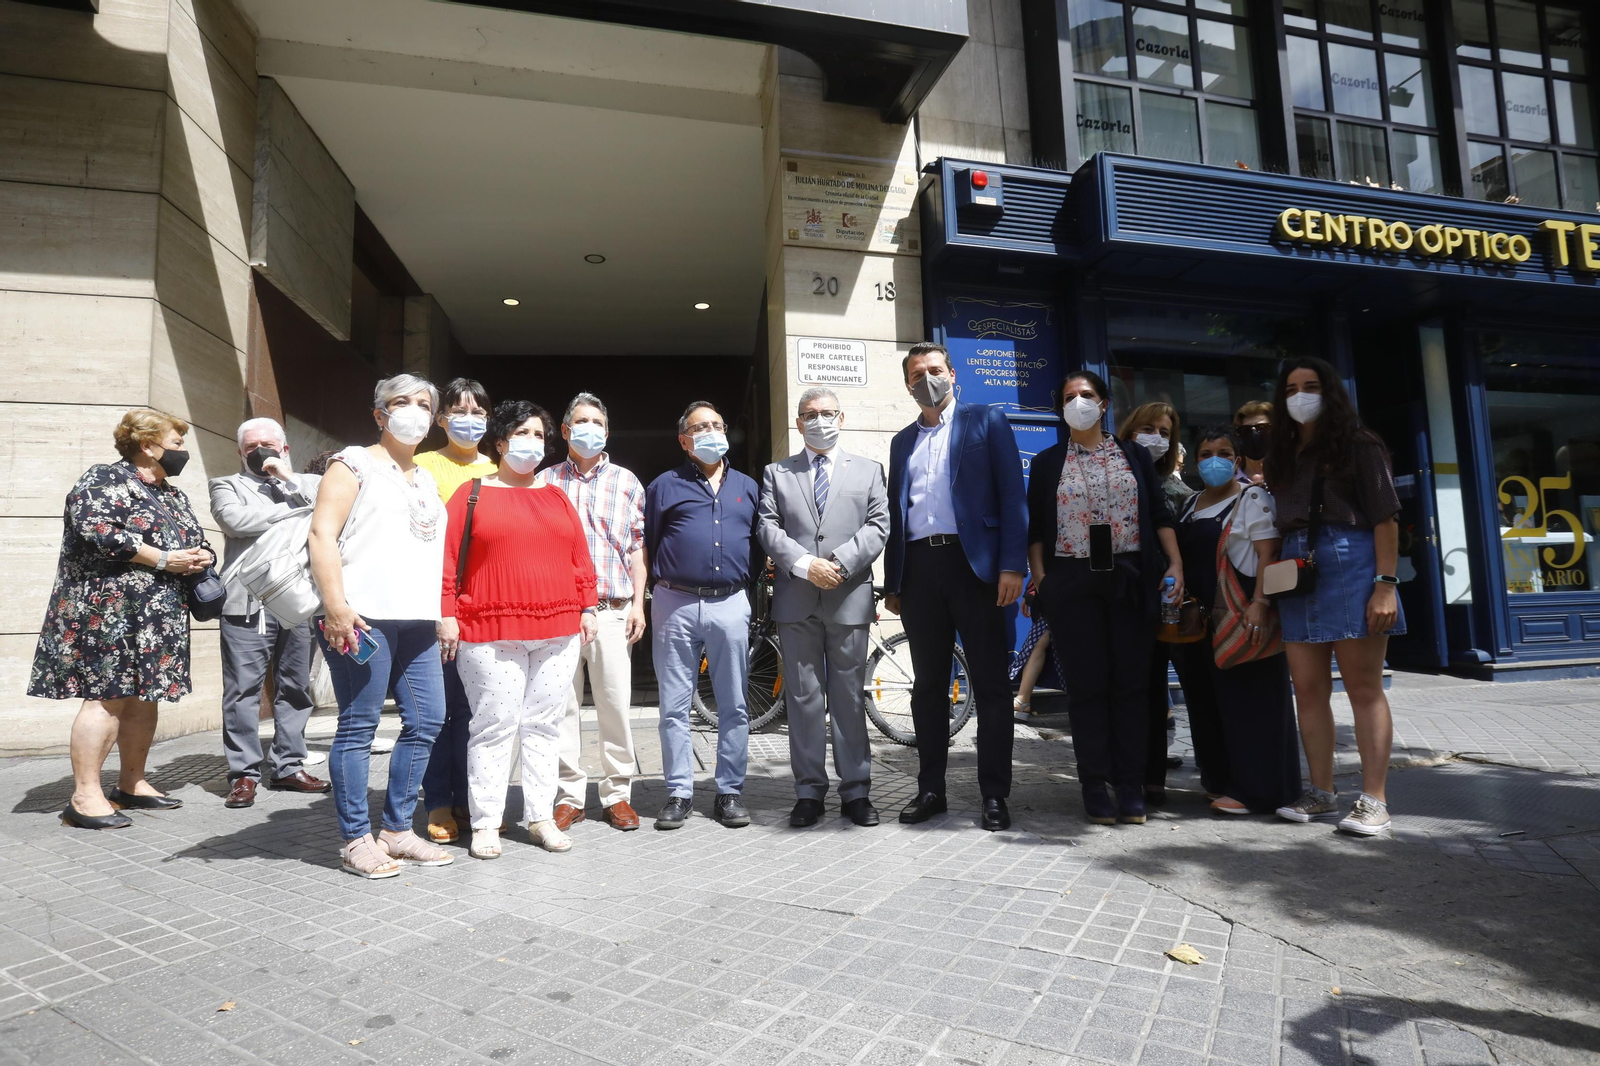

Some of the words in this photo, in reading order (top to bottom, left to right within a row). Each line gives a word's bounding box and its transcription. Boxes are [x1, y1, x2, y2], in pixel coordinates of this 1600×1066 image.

[1380, 4, 1424, 22] Cazorla
[1136, 39, 1190, 60] Cazorla
[1331, 73, 1379, 91] Cazorla
[1506, 101, 1548, 117] Cazorla
[1076, 114, 1131, 135] Cazorla
[795, 176, 816, 185] JULIÁN
[817, 178, 846, 188] HURTADO
[847, 181, 855, 189] DE
[856, 182, 879, 192] MOLINA
[880, 185, 907, 195] DELGADO
[1277, 208, 1414, 251] CENTRO
[1414, 224, 1532, 264] ÓPTICO
[1539, 220, 1600, 271] TE
[813, 277, 840, 297] 20
[875, 282, 897, 302] 18
[977, 322, 1036, 336] ESPECIALISTAS
[813, 343, 852, 351] PROHIBIDO
[977, 349, 1027, 359] OPTOMETRÍA
[829, 354, 864, 362] CARTELES
[967, 358, 991, 366] LENTES
[1004, 359, 1047, 369] CONTACTO
[808, 364, 858, 372] RESPONSABLE
[975, 368, 1029, 378] PROGRESIVOS
[817, 375, 862, 383] ANUNCIANTE
[1498, 471, 1585, 569] 25
